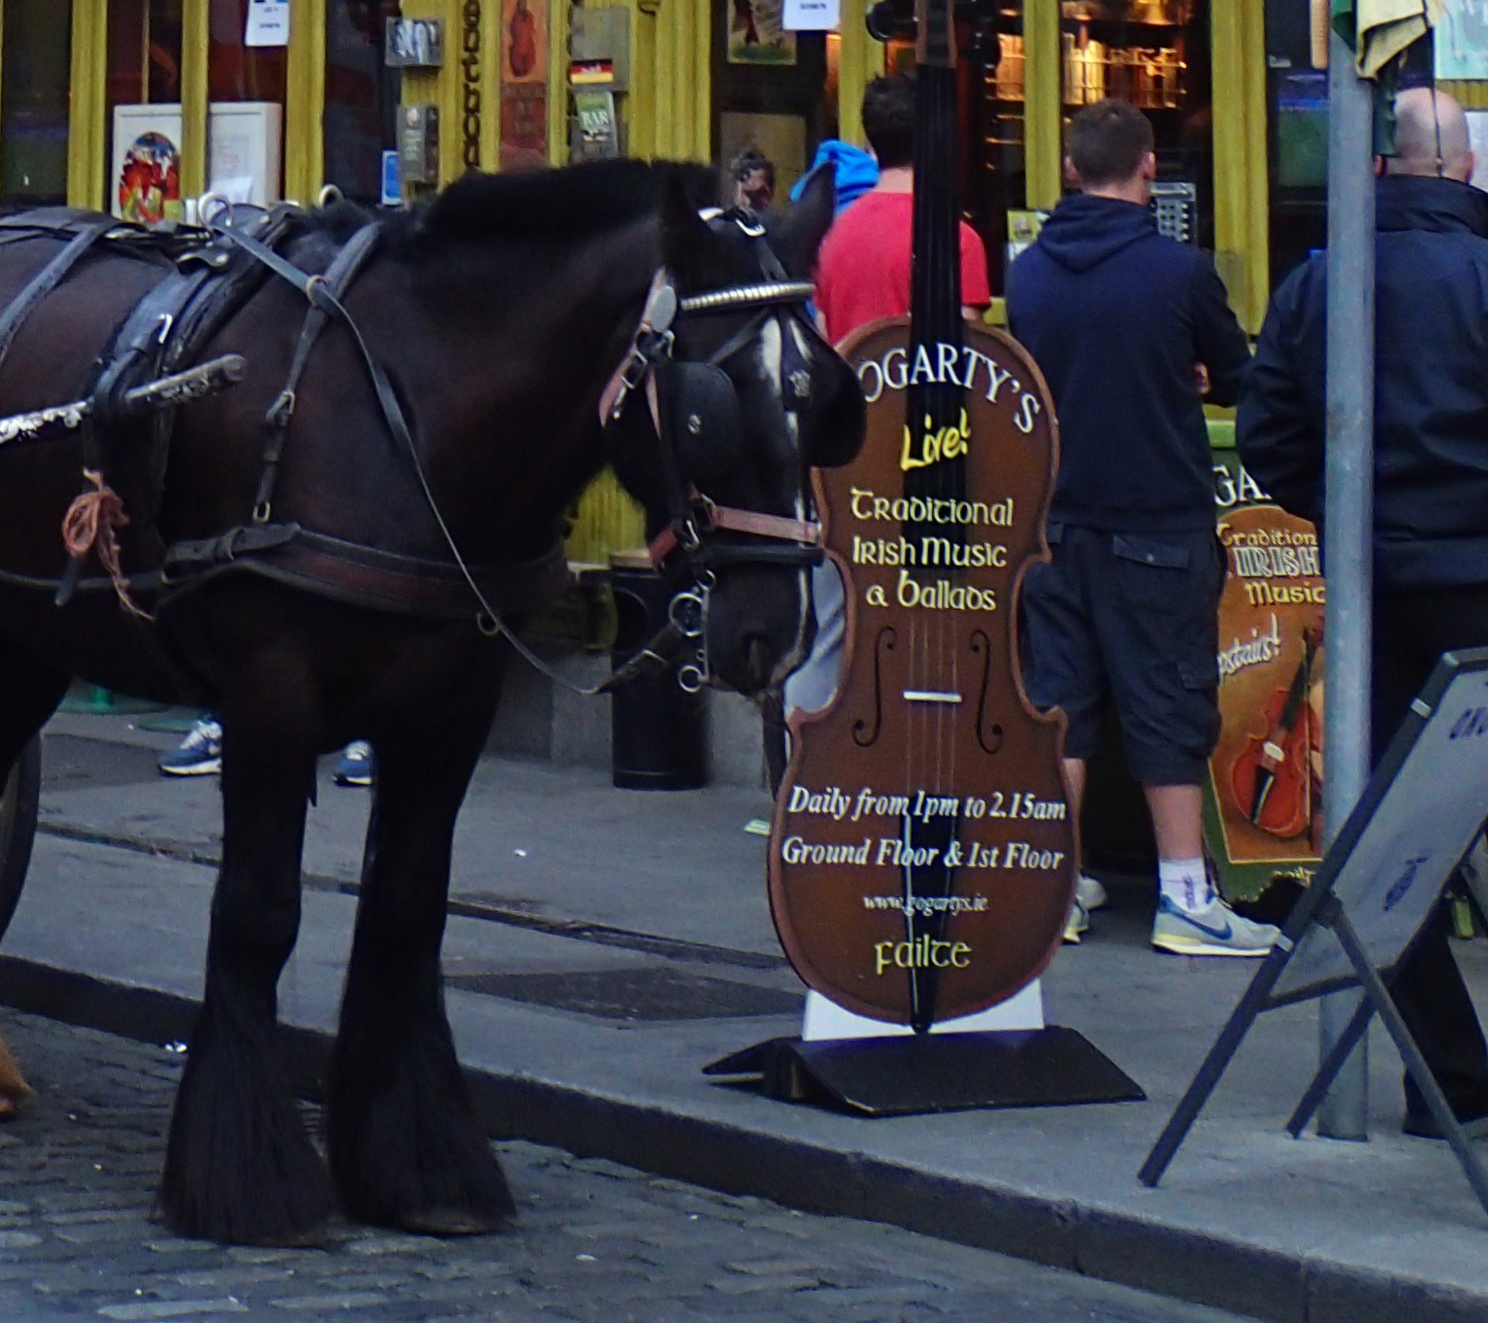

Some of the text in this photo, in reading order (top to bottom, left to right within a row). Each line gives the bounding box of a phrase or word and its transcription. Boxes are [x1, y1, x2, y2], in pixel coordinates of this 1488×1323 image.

[858, 341, 1042, 435] OGARTY'S
[900, 406, 971, 472] Live!
[849, 486, 1014, 527] Traditional
[851, 535, 1008, 568] Irish Music
[1233, 545, 1321, 578] IRISH
[1243, 580, 1326, 606] Music
[788, 785, 1067, 824] Daily from 1pm to 2.15am
[782, 835, 1065, 870] Ground Floor & 1st Floor
